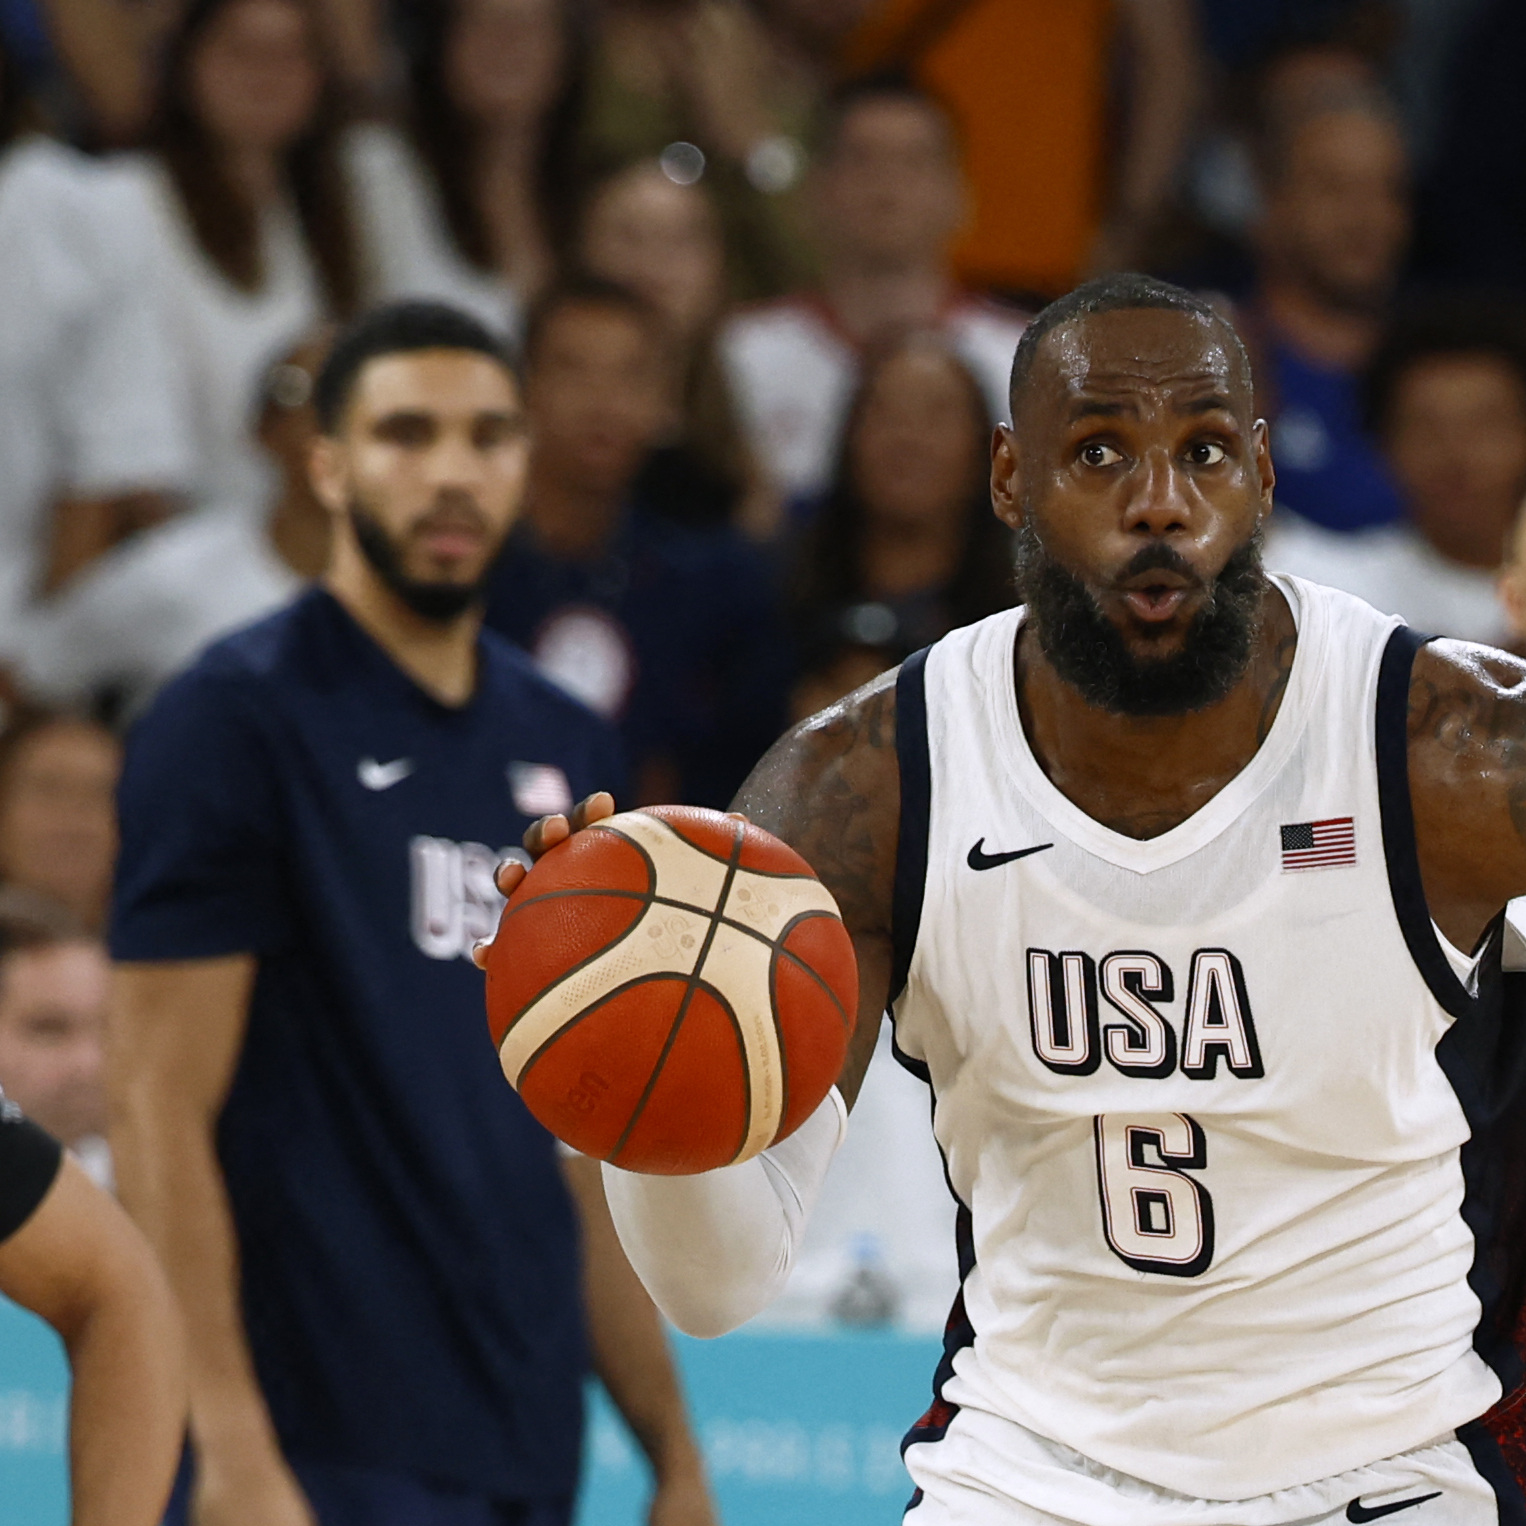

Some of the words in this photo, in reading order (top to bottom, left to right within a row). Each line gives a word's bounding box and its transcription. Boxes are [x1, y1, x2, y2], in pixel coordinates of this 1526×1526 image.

[409, 835, 526, 960] US
[1026, 948, 1265, 1080] USA
[1094, 1111, 1214, 1278] 6
